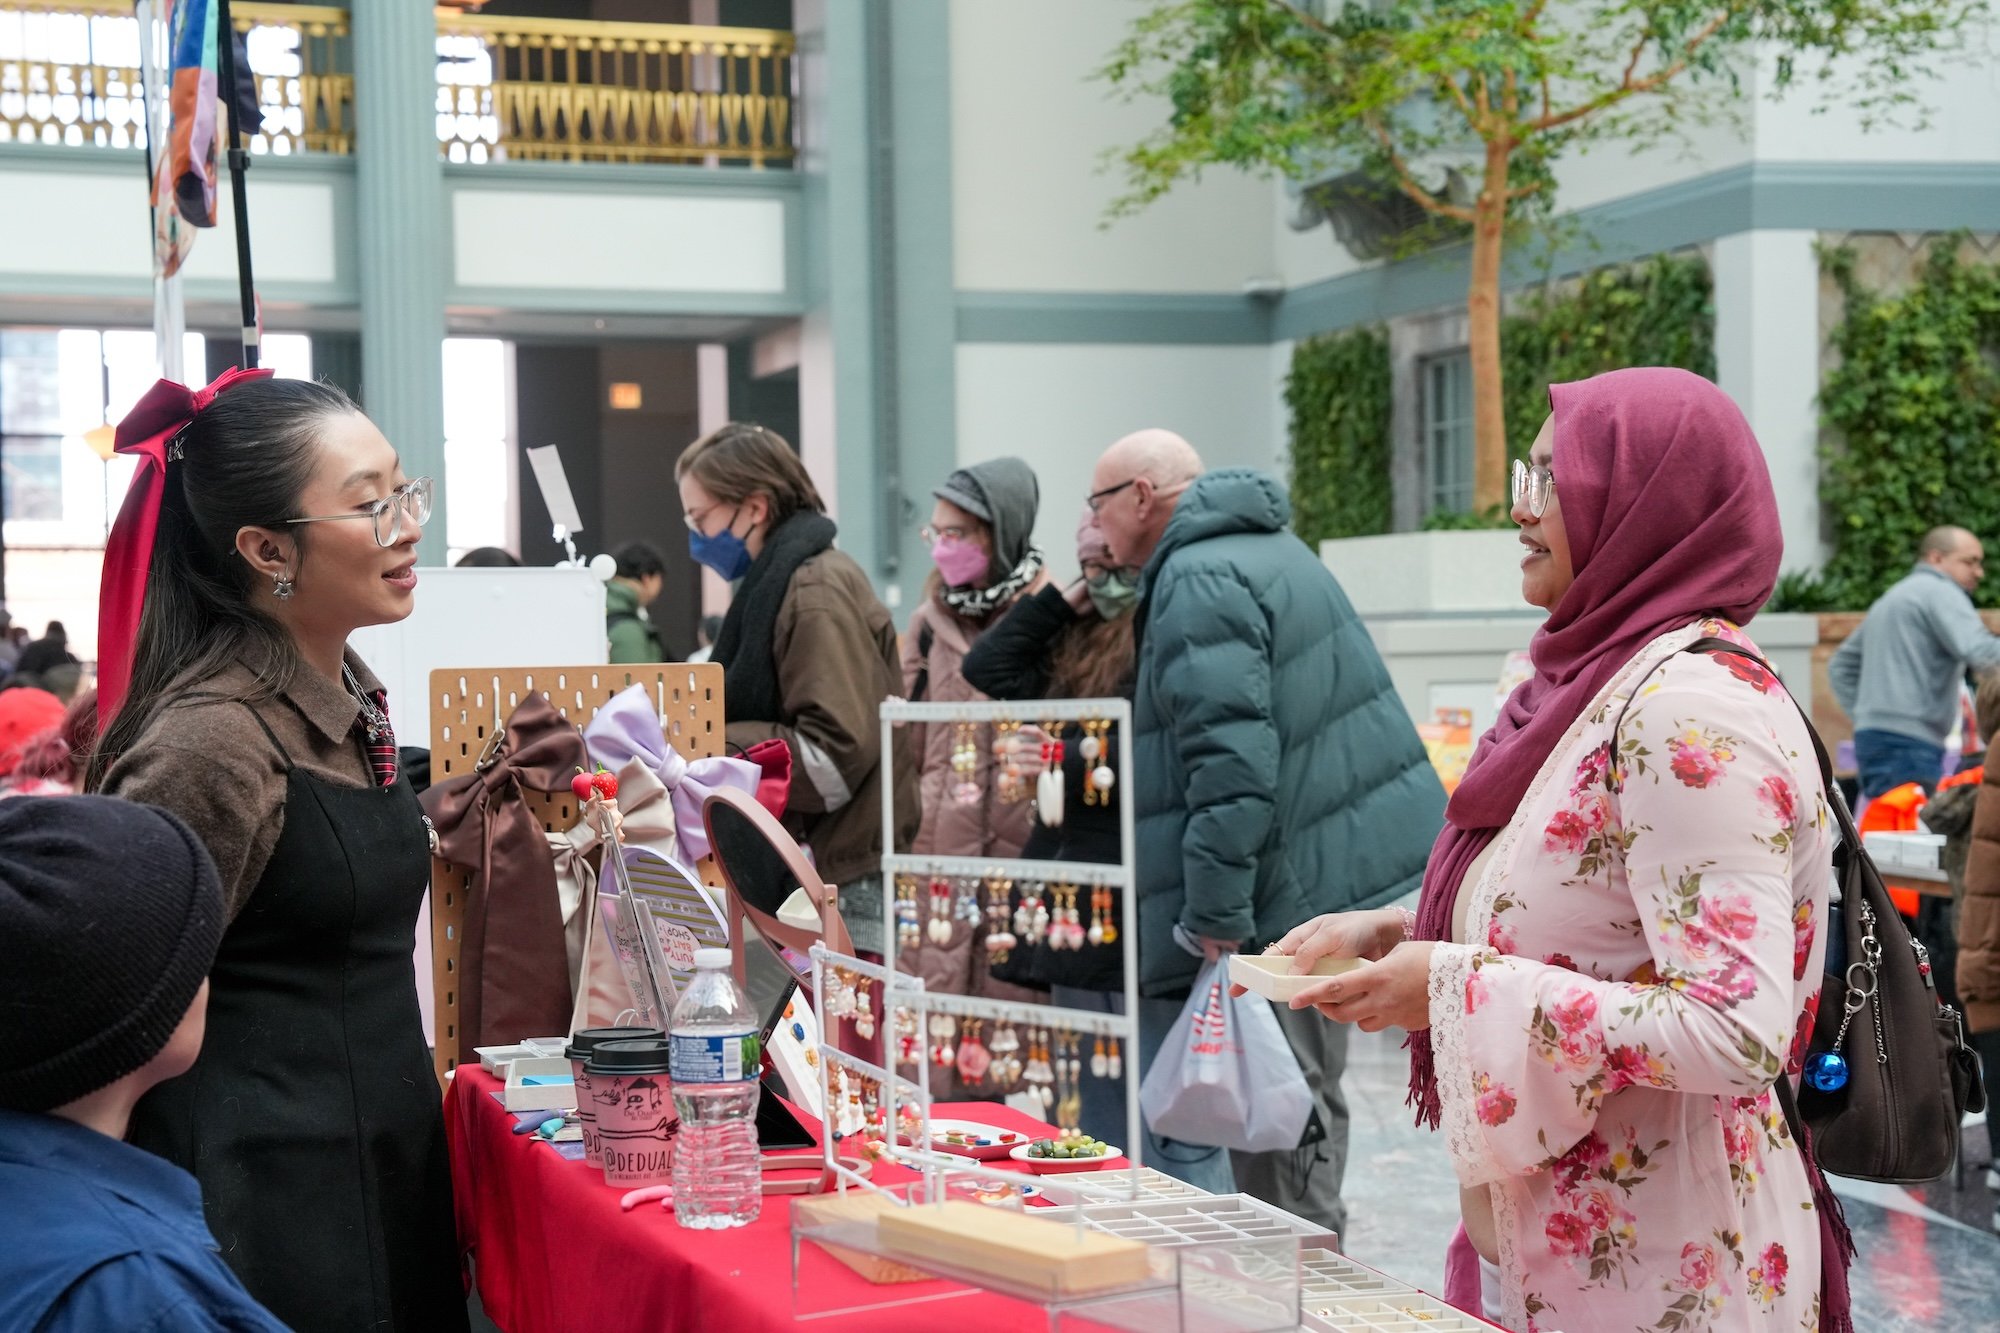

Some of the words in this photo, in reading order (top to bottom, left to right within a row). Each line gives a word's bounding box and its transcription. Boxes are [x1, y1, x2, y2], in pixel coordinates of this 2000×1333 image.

[668, 927, 690, 941] SHOP
[673, 940, 692, 952] BAIT
[671, 951, 695, 965] RUITY
[605, 1147, 673, 1172] @DEDUAL
